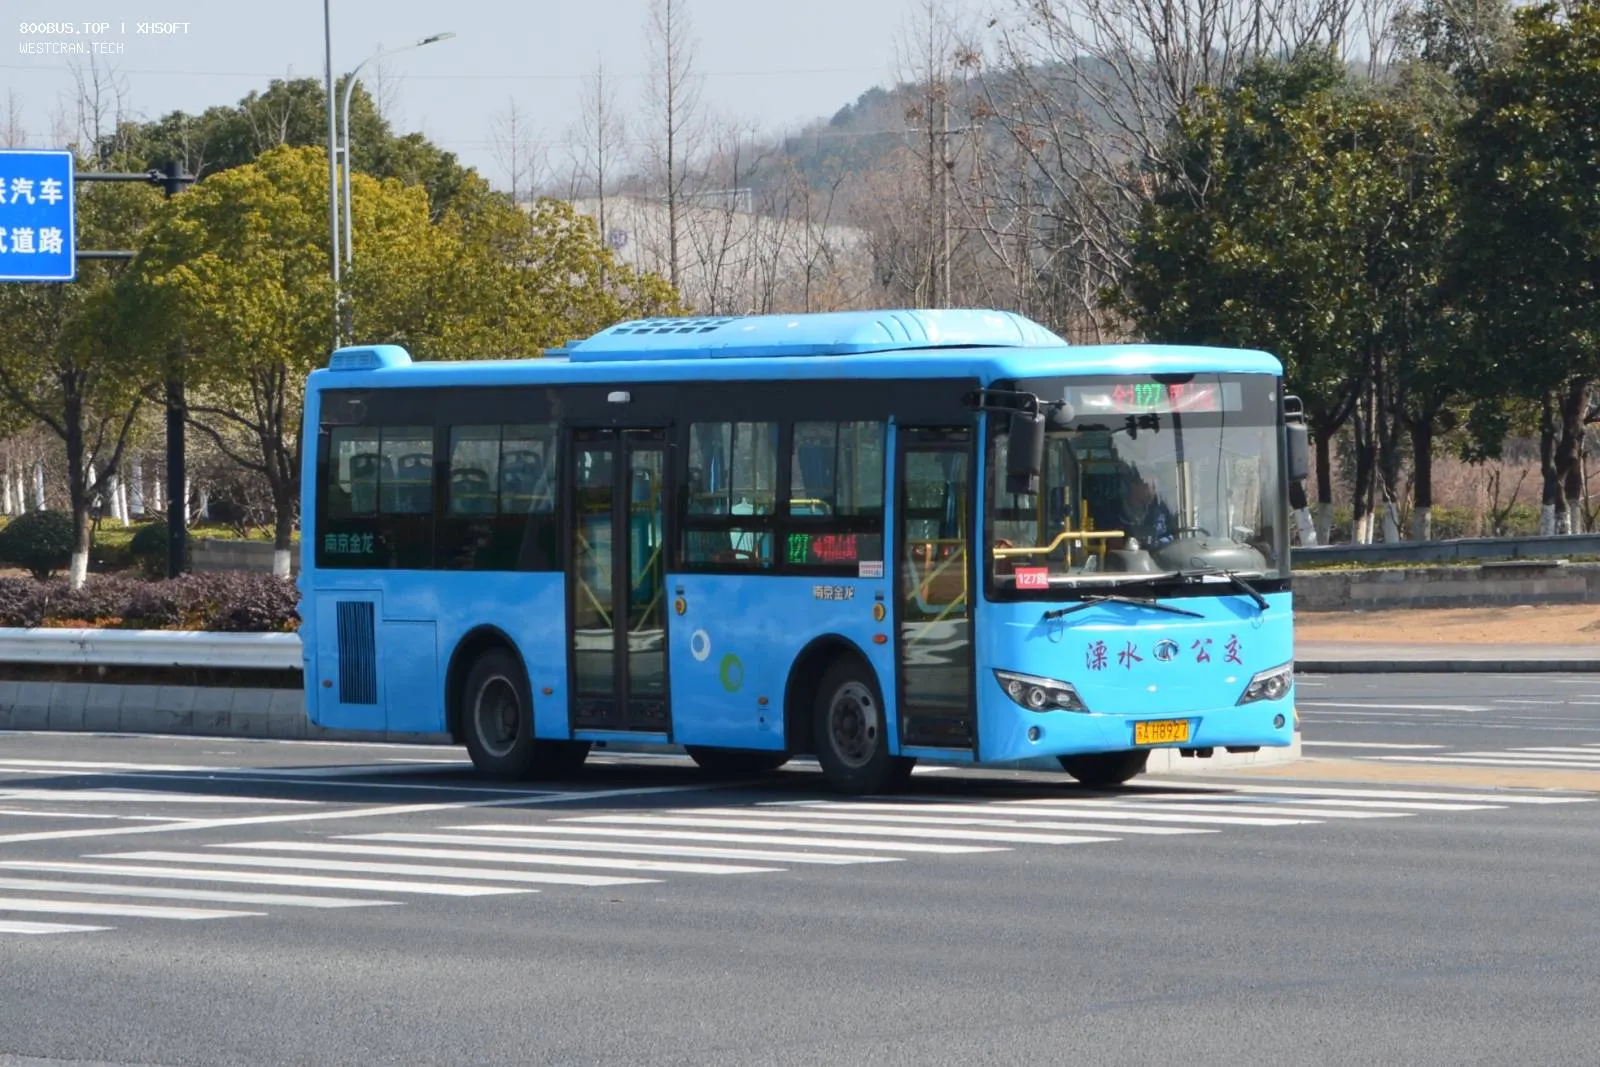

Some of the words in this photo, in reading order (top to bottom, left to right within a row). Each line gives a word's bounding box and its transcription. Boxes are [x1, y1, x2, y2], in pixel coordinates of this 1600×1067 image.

[0, 177, 64, 206] 汽车
[1135, 383, 1162, 408] 127
[324, 532, 374, 554] 南京金龙
[813, 585, 855, 600] 南京金龙
